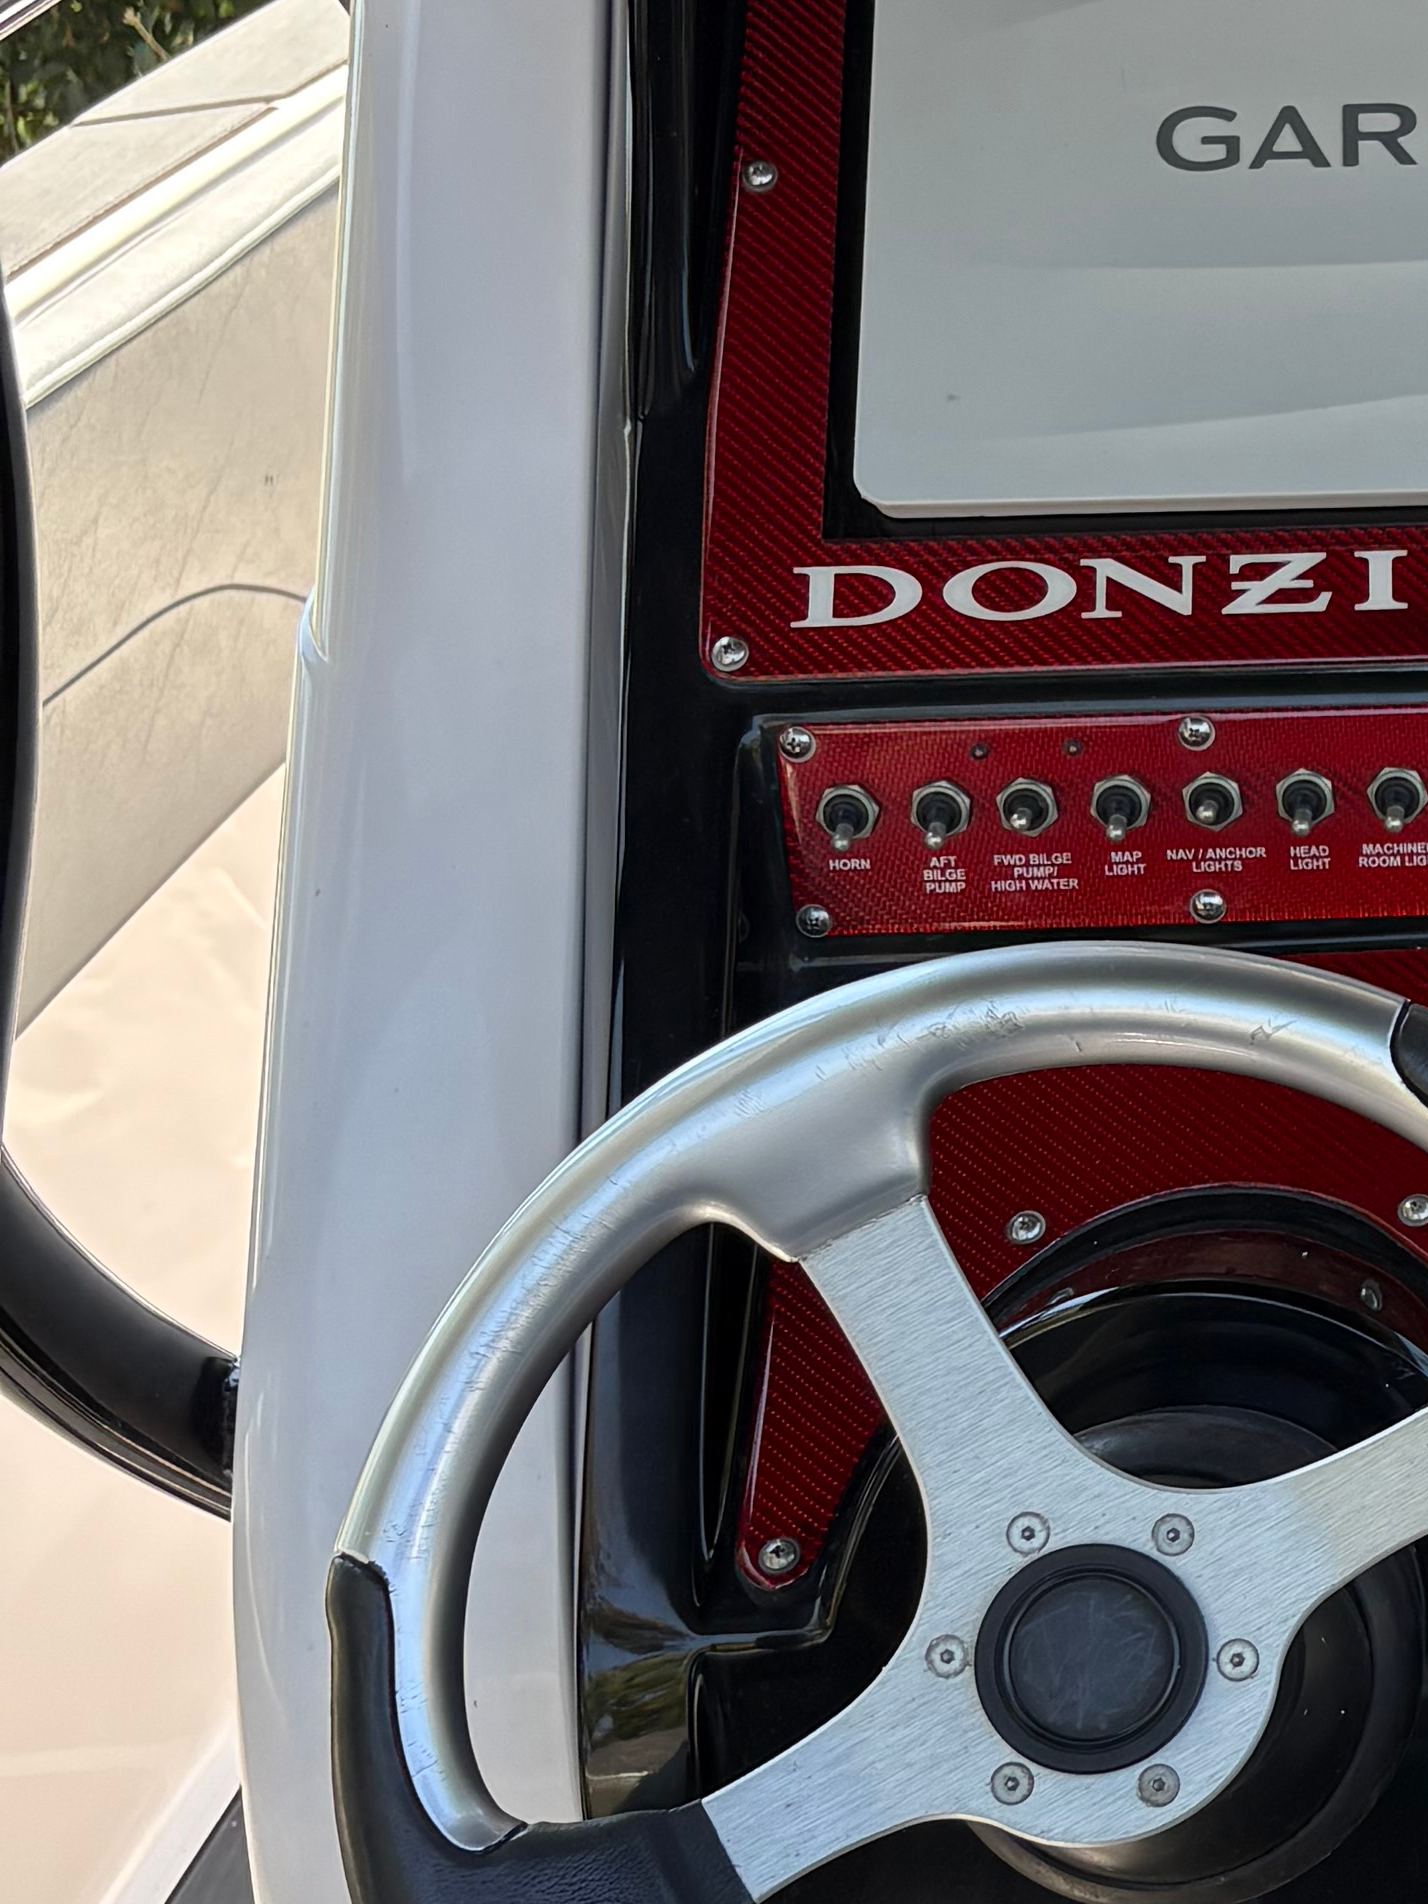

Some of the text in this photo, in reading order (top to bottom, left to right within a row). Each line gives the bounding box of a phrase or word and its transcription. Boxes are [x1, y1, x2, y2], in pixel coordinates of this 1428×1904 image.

[790, 550, 1408, 629] DONZI
[1110, 851, 1142, 863] MAP
[1166, 847, 1267, 860] NAV ANCHOR
[1290, 845, 1329, 857] HEAD
[829, 859, 871, 870] HORN
[930, 856, 957, 868] AFT
[993, 853, 1072, 866] FWD BILGE
[1290, 858, 1331, 870] LIGHT
[1358, 856, 1401, 868] ROOM
[1014, 866, 1058, 878] PUMP/
[1105, 864, 1147, 876] LIGHT
[1192, 860, 1243, 873] LIGHTS
[923, 869, 966, 881] BILGE
[926, 882, 966, 894] PUMP
[991, 878, 1079, 892] HIGH WATER
